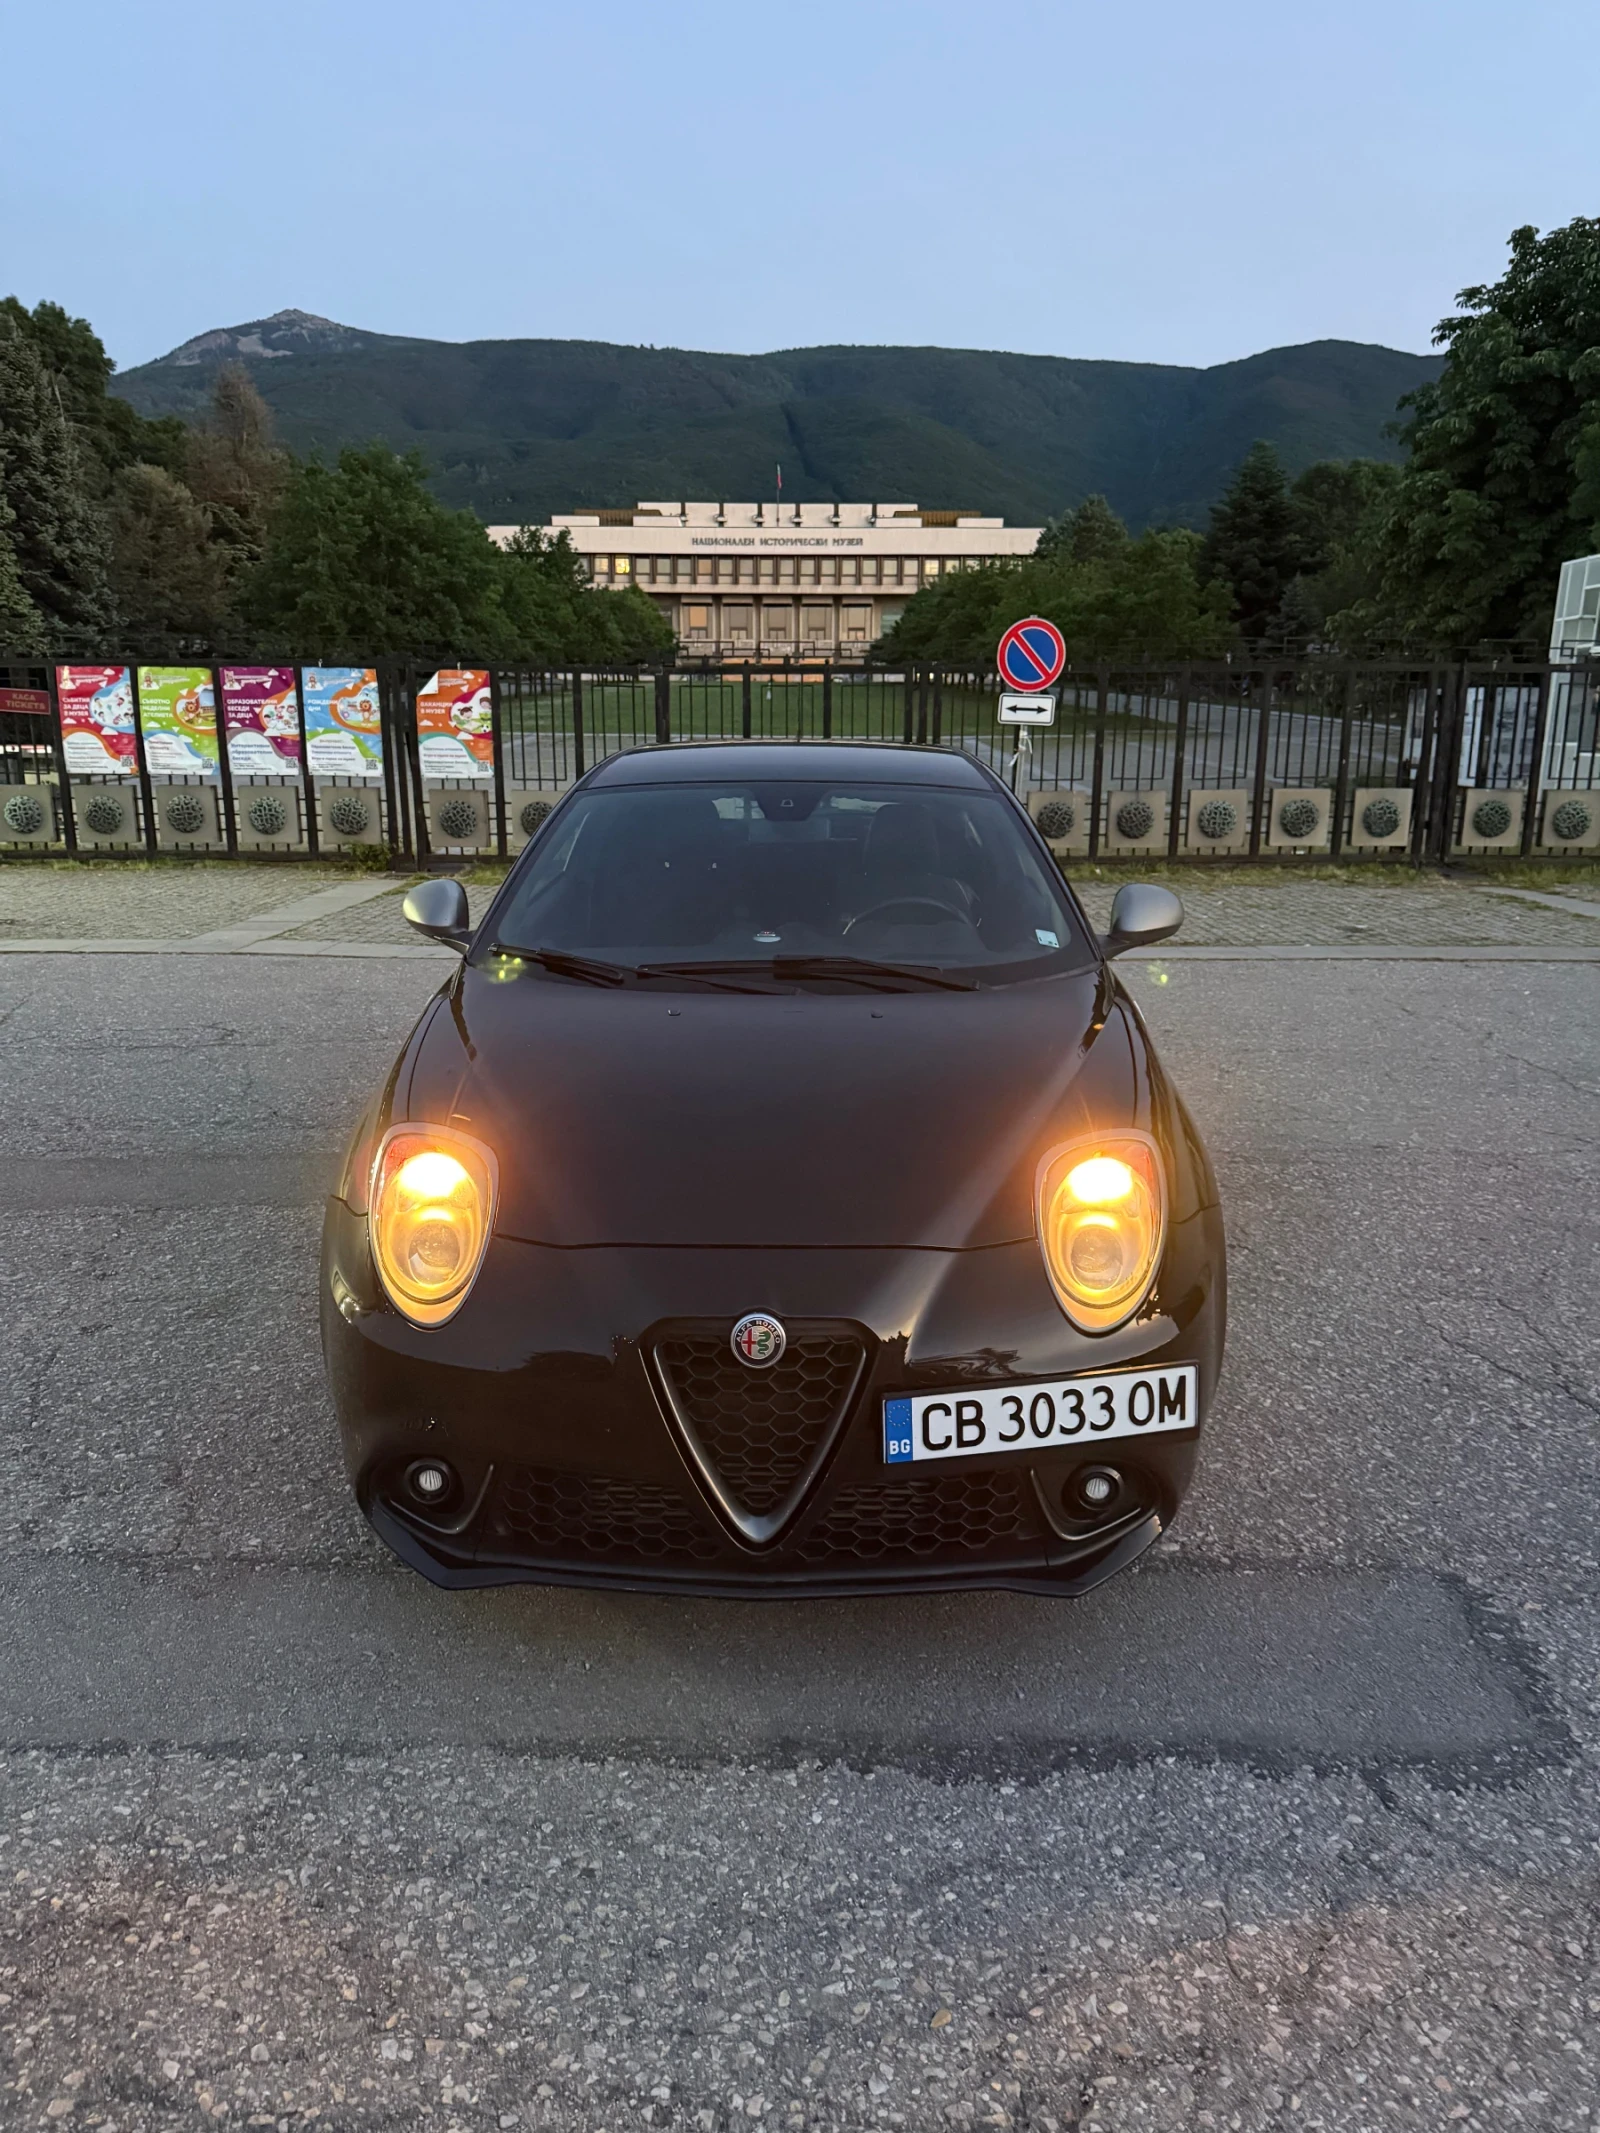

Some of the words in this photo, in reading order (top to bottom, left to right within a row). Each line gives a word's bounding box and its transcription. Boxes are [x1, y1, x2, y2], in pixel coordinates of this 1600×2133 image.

[692, 538, 755, 546] НАЦИОНАЛЕН
[760, 538, 827, 546] ИСТОРИЧЕСКИ
[832, 538, 863, 546] МУЗЕЙ
[12, 693, 36, 701] КАСА
[5, 700, 46, 710] TICKETS
[736, 1323, 752, 1343] ALFA
[755, 1320, 781, 1344] ROMEO
[921, 1399, 986, 1451] CB
[998, 1385, 1116, 1442] 3033
[1128, 1374, 1187, 1426] OM
[889, 1438, 911, 1455] BG
